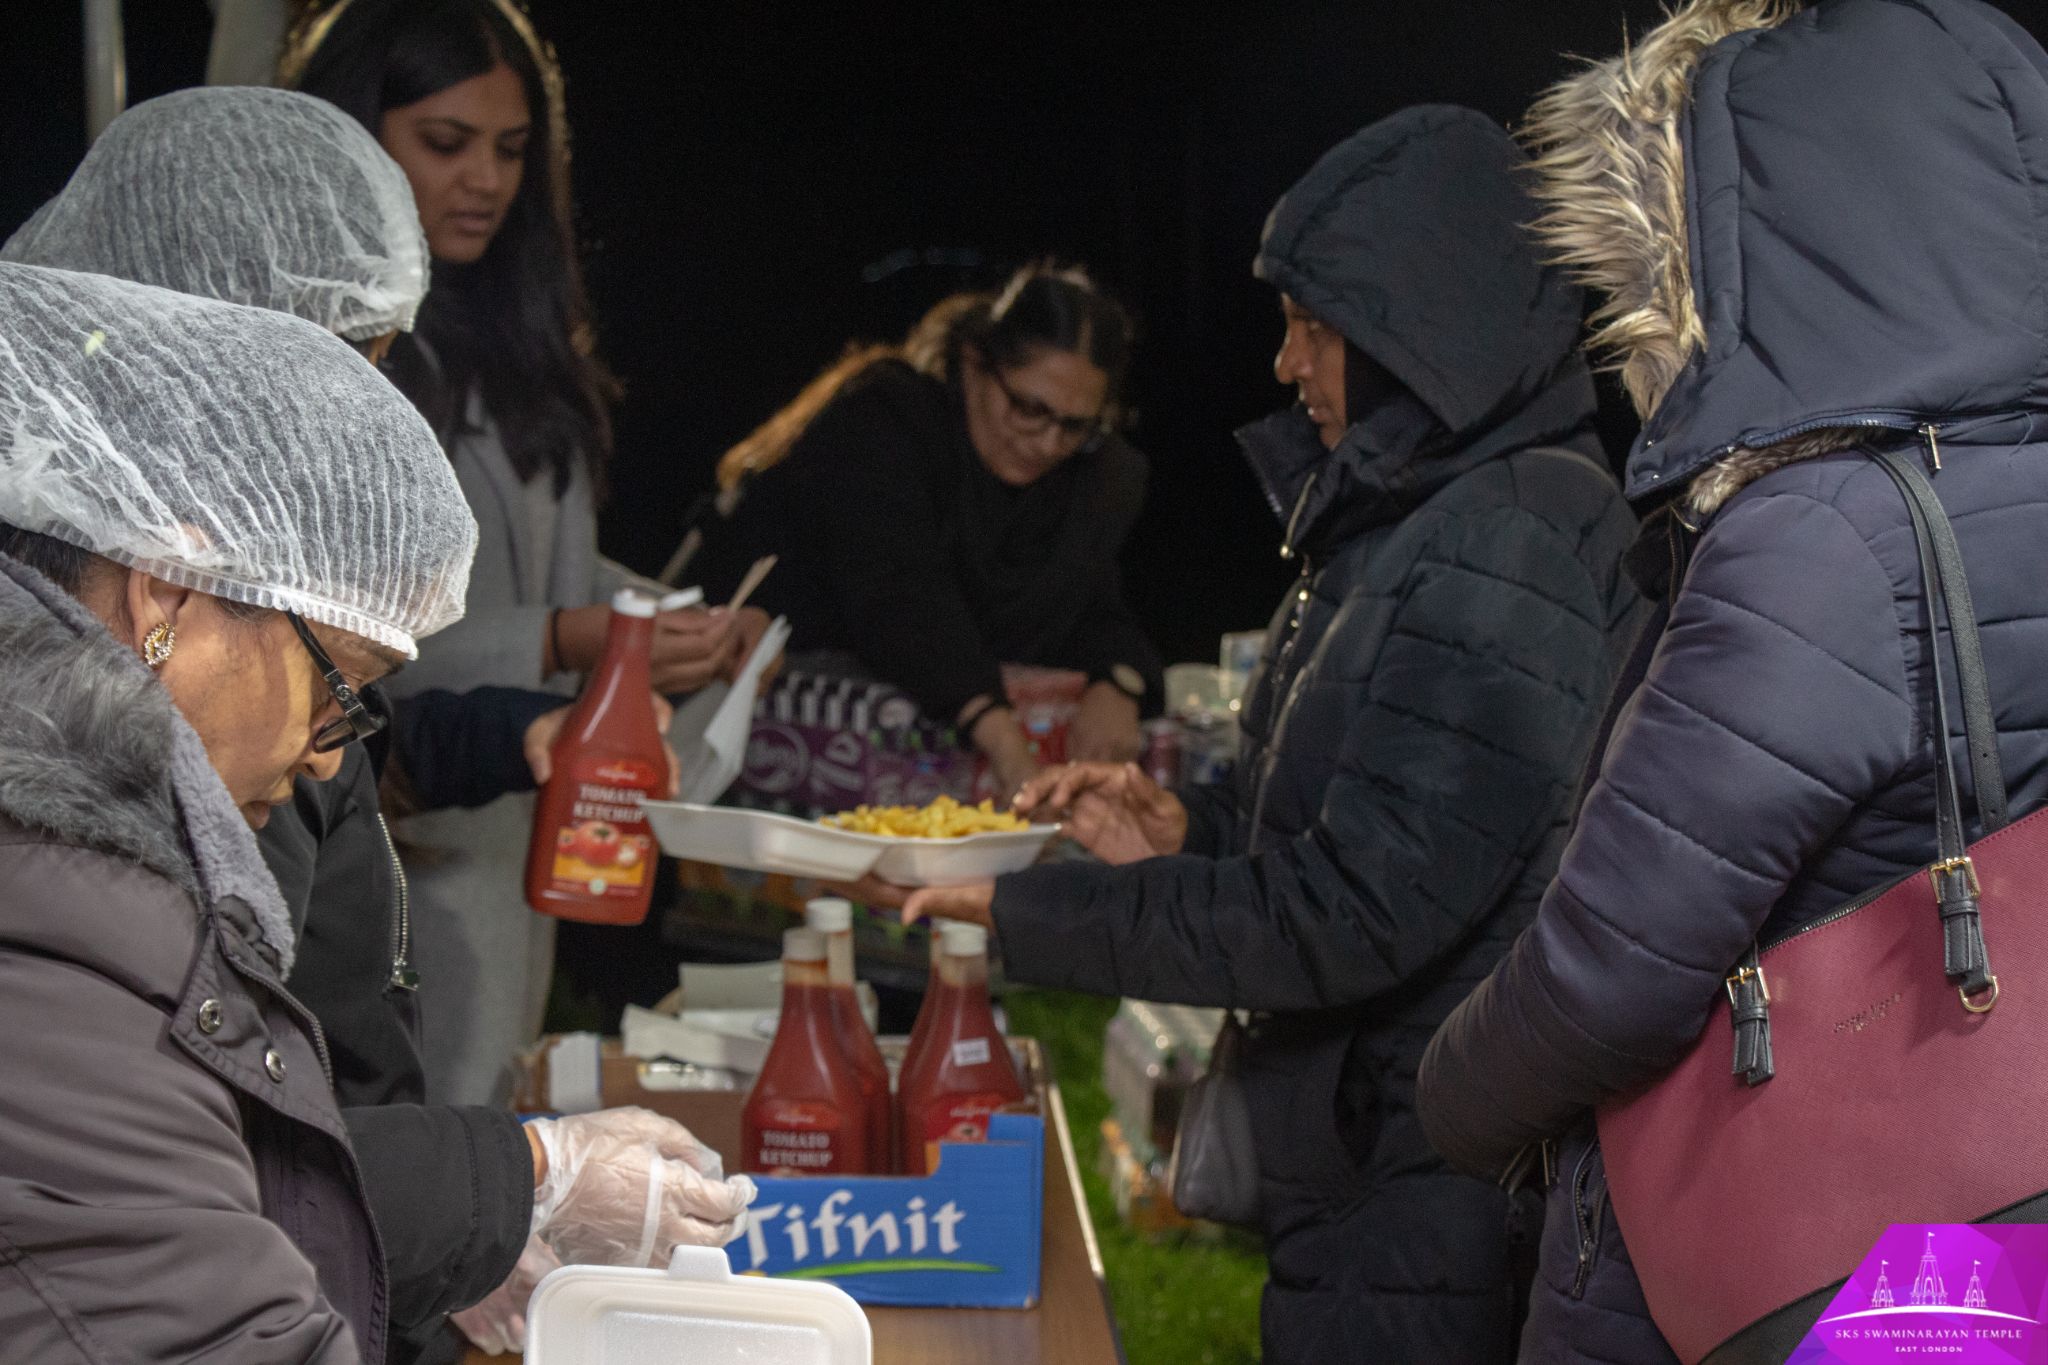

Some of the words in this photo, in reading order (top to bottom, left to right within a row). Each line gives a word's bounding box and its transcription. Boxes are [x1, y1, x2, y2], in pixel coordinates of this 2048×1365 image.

[579, 784, 646, 804] TOMATO
[573, 800, 644, 823] KETCHUP
[761, 1130, 830, 1149] TOMATO
[759, 1148, 833, 1167] KETCHUP
[747, 1189, 966, 1268] Tifnit
